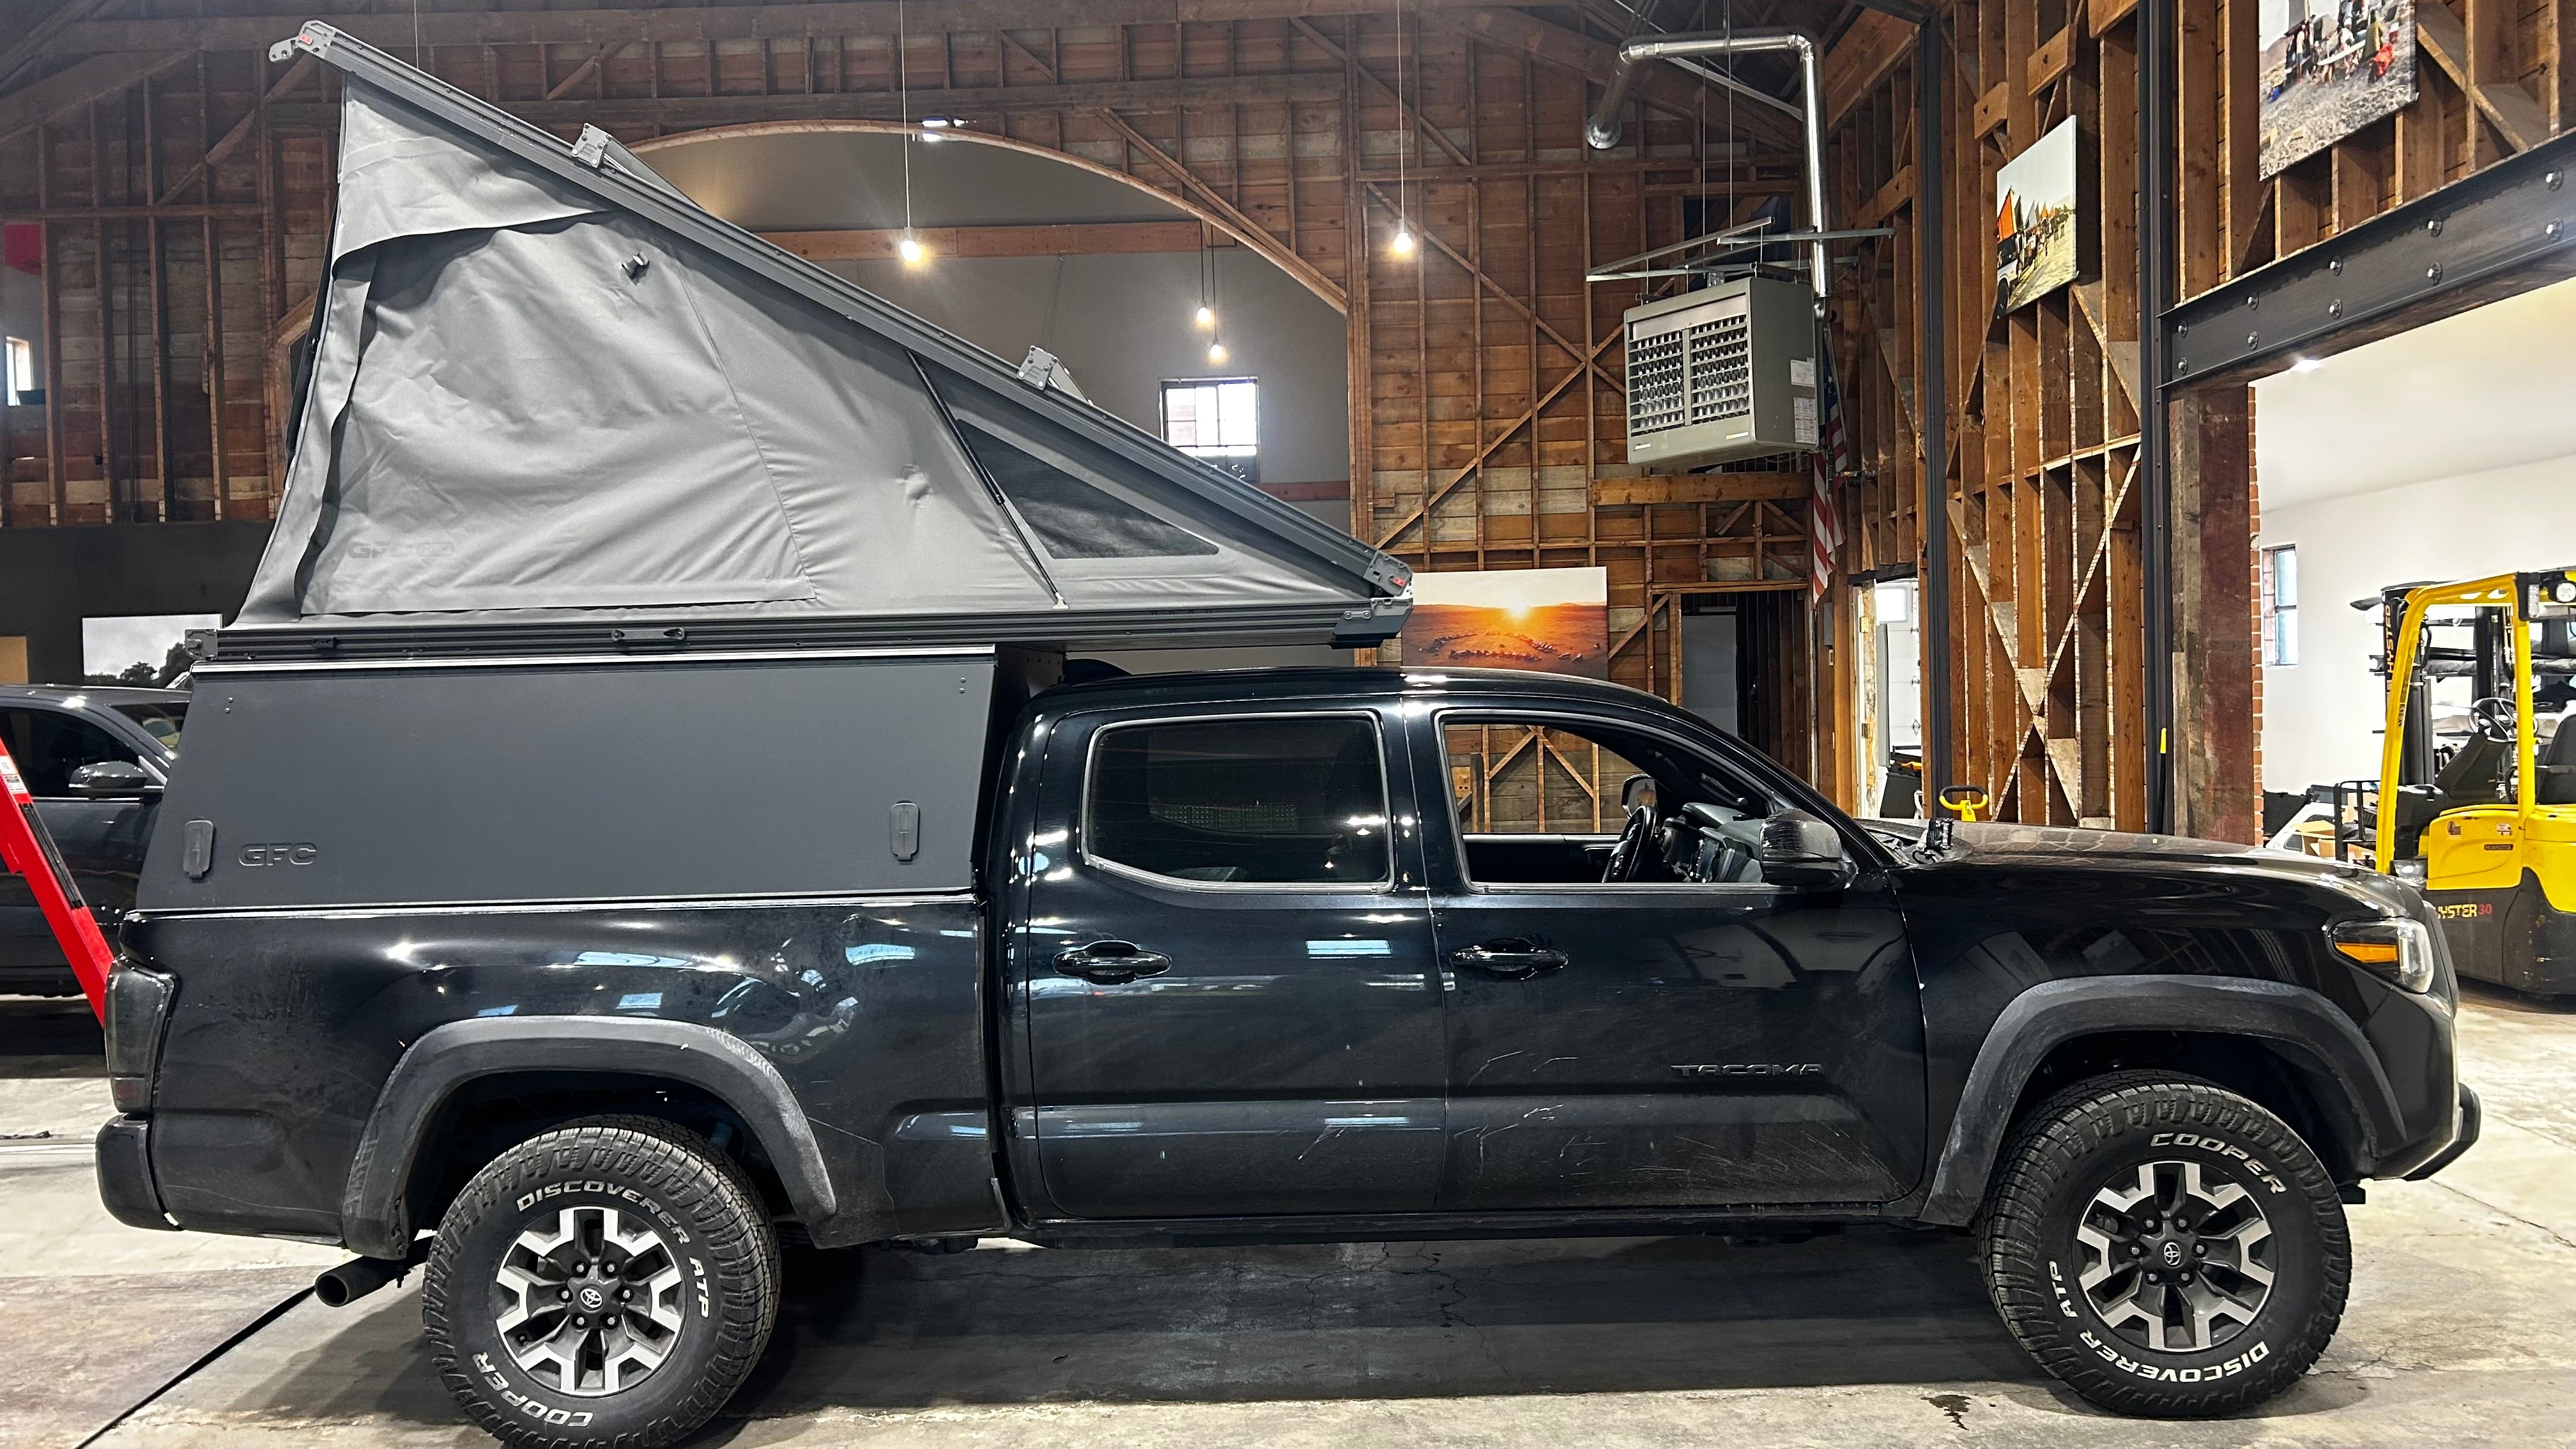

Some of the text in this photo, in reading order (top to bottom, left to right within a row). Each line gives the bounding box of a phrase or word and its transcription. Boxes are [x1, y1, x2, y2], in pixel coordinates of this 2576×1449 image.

[238, 842, 317, 866] GFC
[2478, 903, 2493, 916] 30
[1670, 1064, 1824, 1077] TACOMA
[2149, 1133, 2287, 1195] COOPER
[517, 1180, 710, 1319] DISCOVERER ATP
[2048, 1261, 2270, 1383] DISCOVERER ATP
[471, 1351, 594, 1428] COOPER
